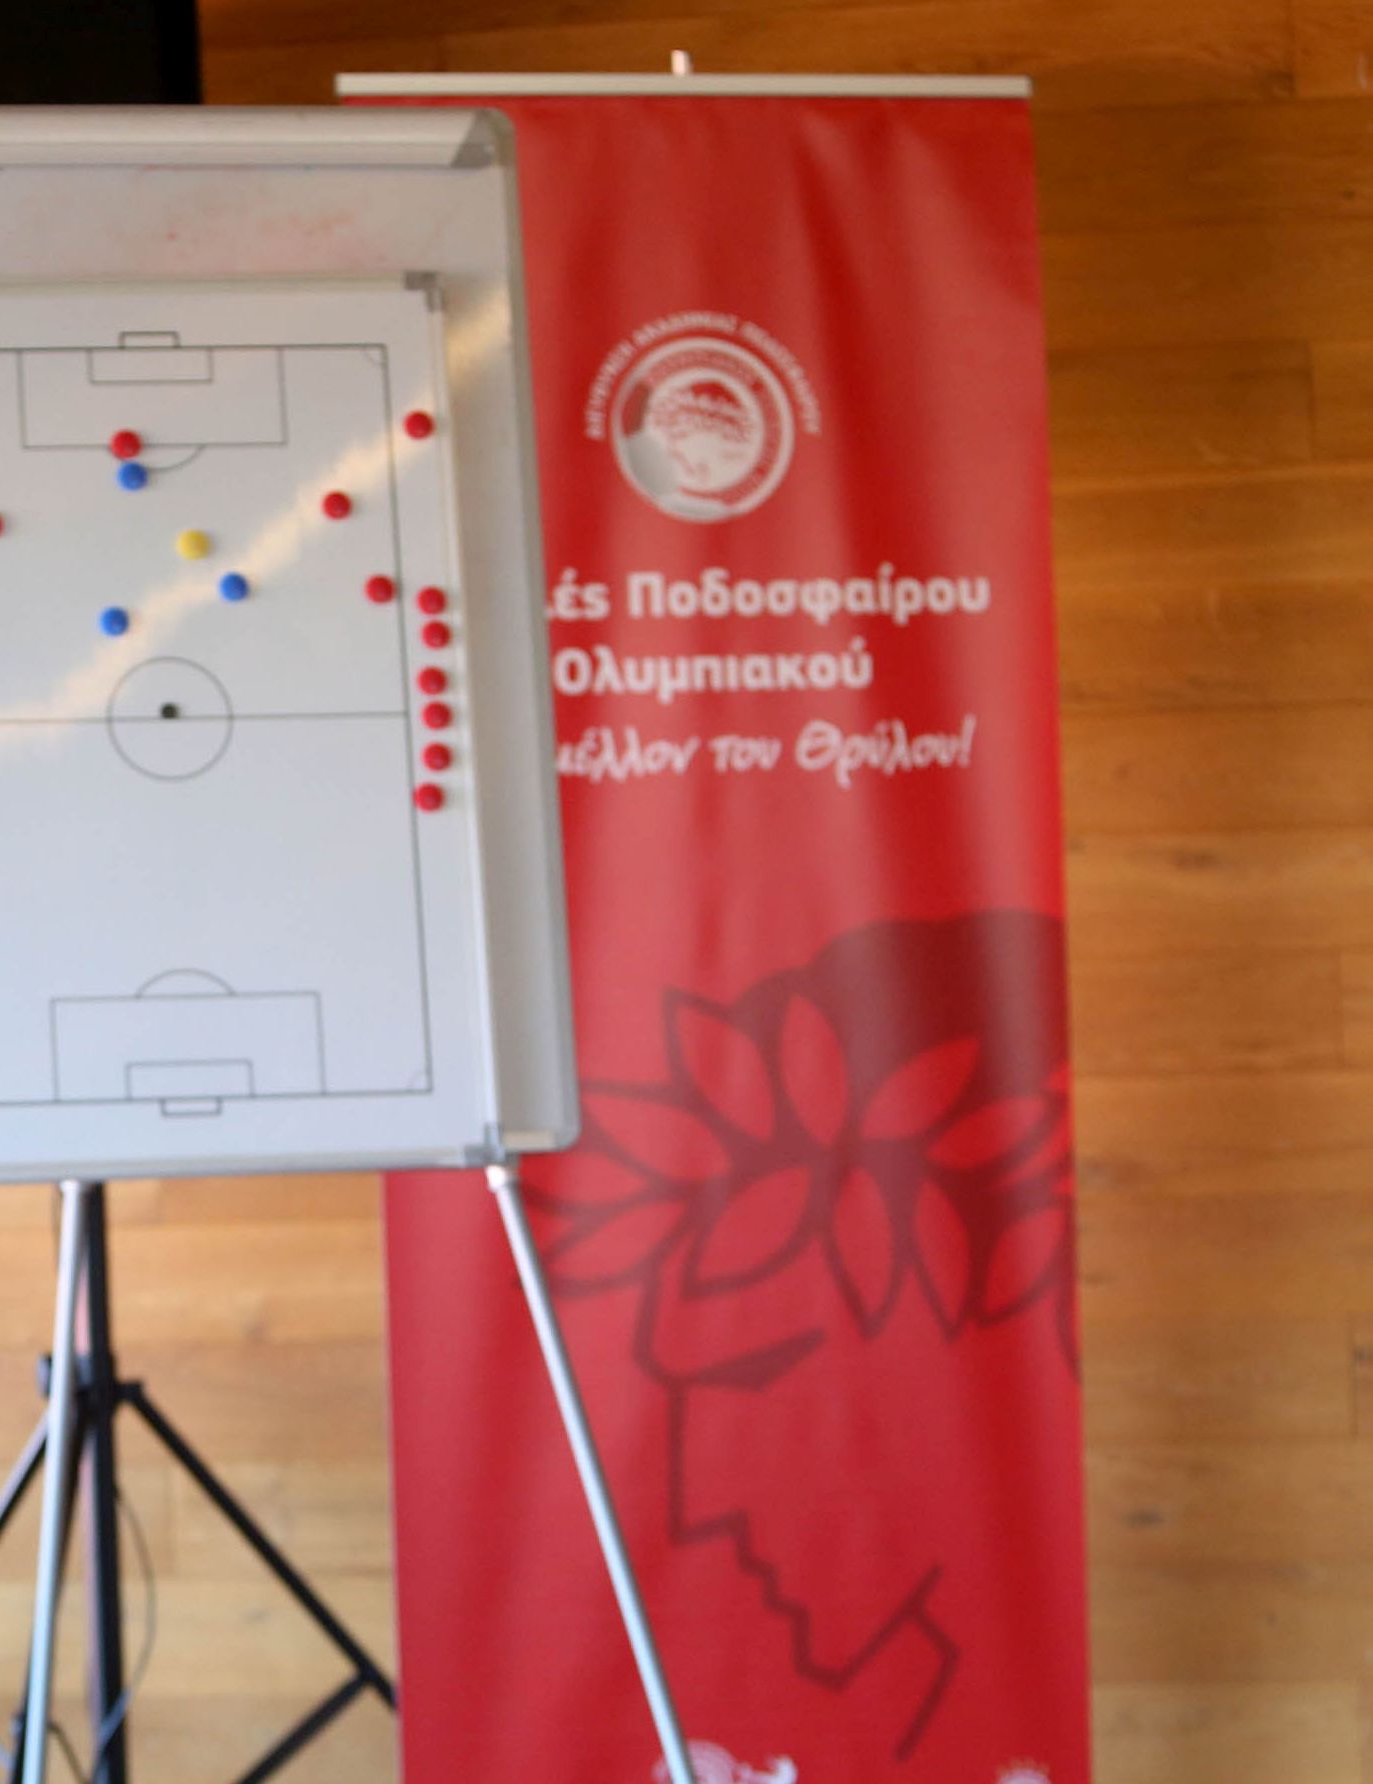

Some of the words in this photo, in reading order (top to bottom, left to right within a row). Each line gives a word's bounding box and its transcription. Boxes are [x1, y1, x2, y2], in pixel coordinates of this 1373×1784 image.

[545, 566, 611, 621] ές
[627, 561, 991, 626] Ποδοσφαίρου
[552, 636, 874, 705] Ολυμπιακού
[795, 714, 978, 790] Θρύλου!
